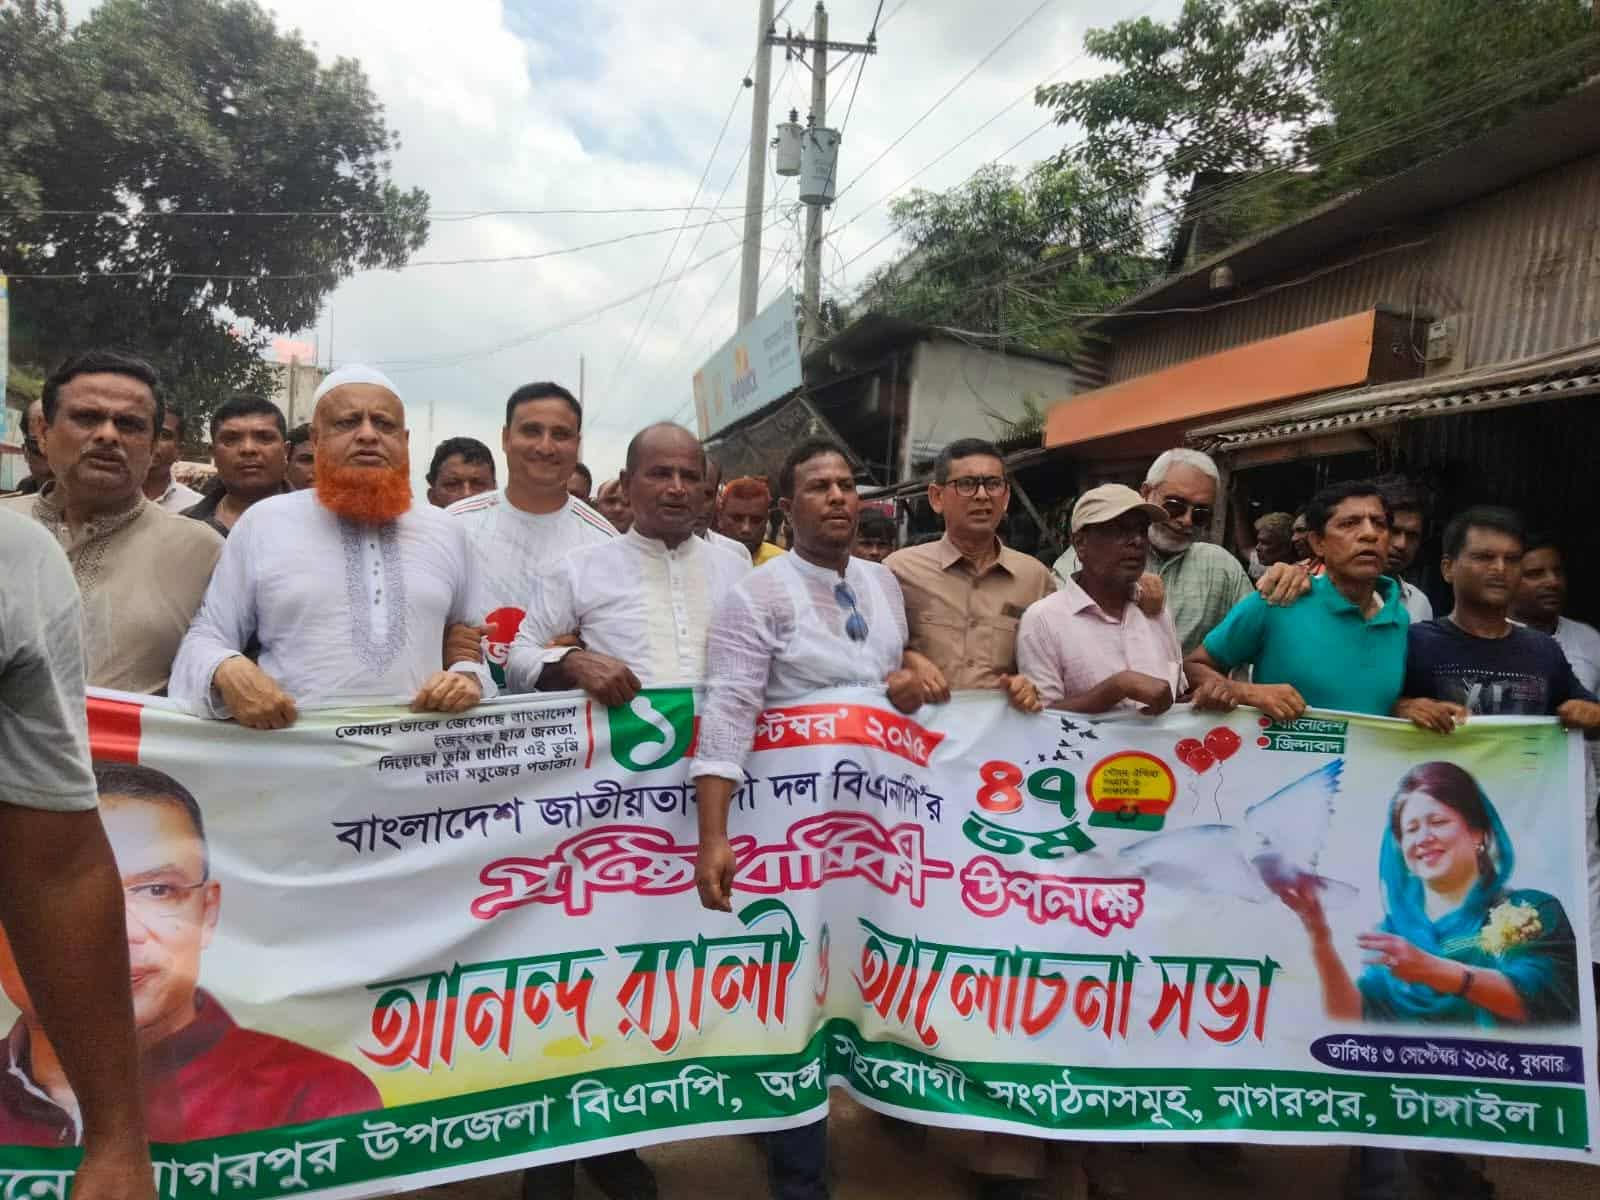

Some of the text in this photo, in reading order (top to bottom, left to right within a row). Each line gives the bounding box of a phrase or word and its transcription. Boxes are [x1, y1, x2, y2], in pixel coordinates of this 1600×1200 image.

[629, 695, 676, 765] ১
[332, 797, 525, 853] বাংলাদেশ
[768, 772, 821, 806] দল
[976, 760, 1077, 822] ৪৭
[961, 855, 1146, 937] উপলক্ষে
[357, 948, 610, 1074] আনন্দ
[852, 915, 1144, 1048] আলোচনা
[1147, 953, 1284, 1046] সভা
[1464, 1050, 1516, 1075] ২০২৫,
[1520, 1053, 1565, 1078] বুধবার
[359, 1096, 555, 1161] উপজেলা
[567, 1064, 744, 1128] বিএনপি,
[984, 1070, 1203, 1128] সংগঠনসমূহ,
[1213, 1083, 1377, 1127] নাগরপুর,
[1390, 1083, 1541, 1134] টাঙ্গাইল
